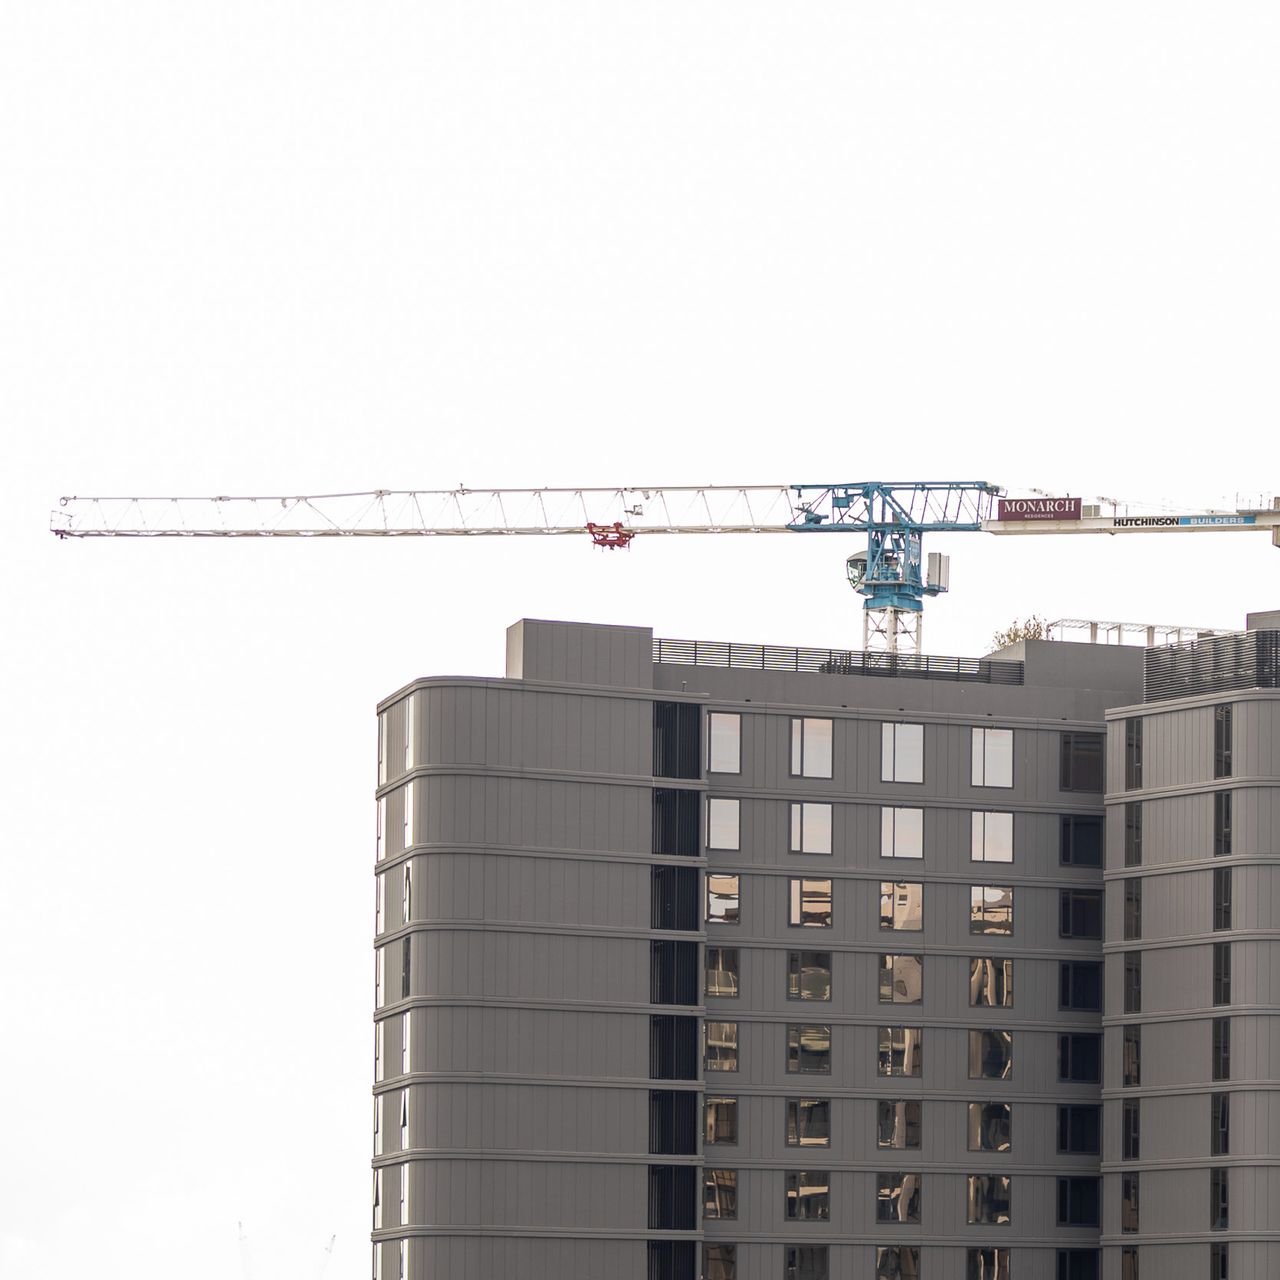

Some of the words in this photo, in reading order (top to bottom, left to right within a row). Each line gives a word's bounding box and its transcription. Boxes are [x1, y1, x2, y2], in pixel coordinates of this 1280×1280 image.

[1004, 500, 1075, 513] MONARCH
[1114, 517, 1180, 527] HUTCHINSON
[1190, 516, 1245, 525] BUILDERS
